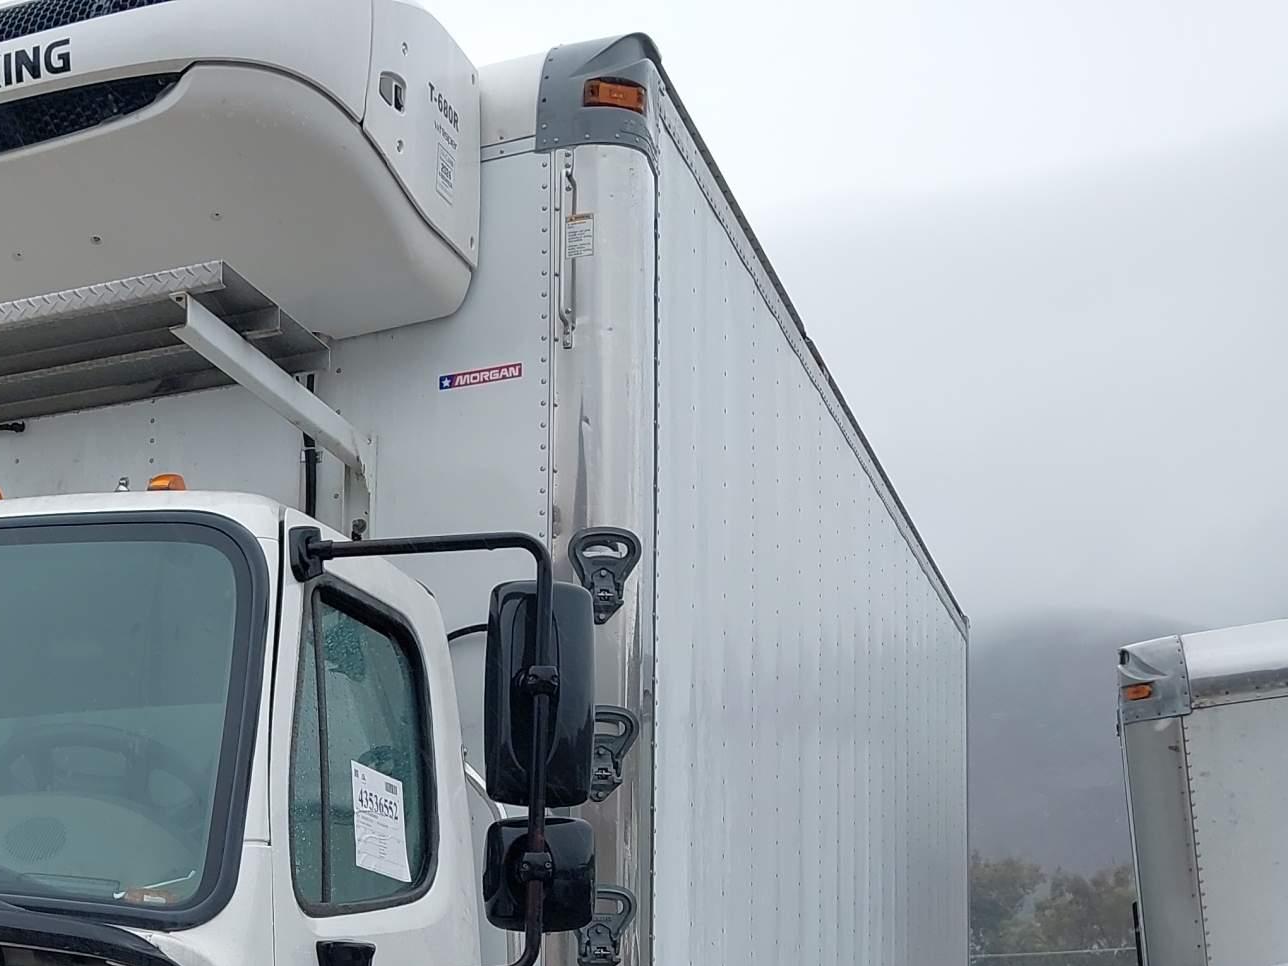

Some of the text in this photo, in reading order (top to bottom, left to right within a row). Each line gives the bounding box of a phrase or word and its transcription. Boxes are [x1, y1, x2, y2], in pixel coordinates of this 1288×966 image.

[428, 81, 461, 133] T-680R
[454, 365, 521, 386] MORGAN
[358, 788, 400, 821] 43536552
